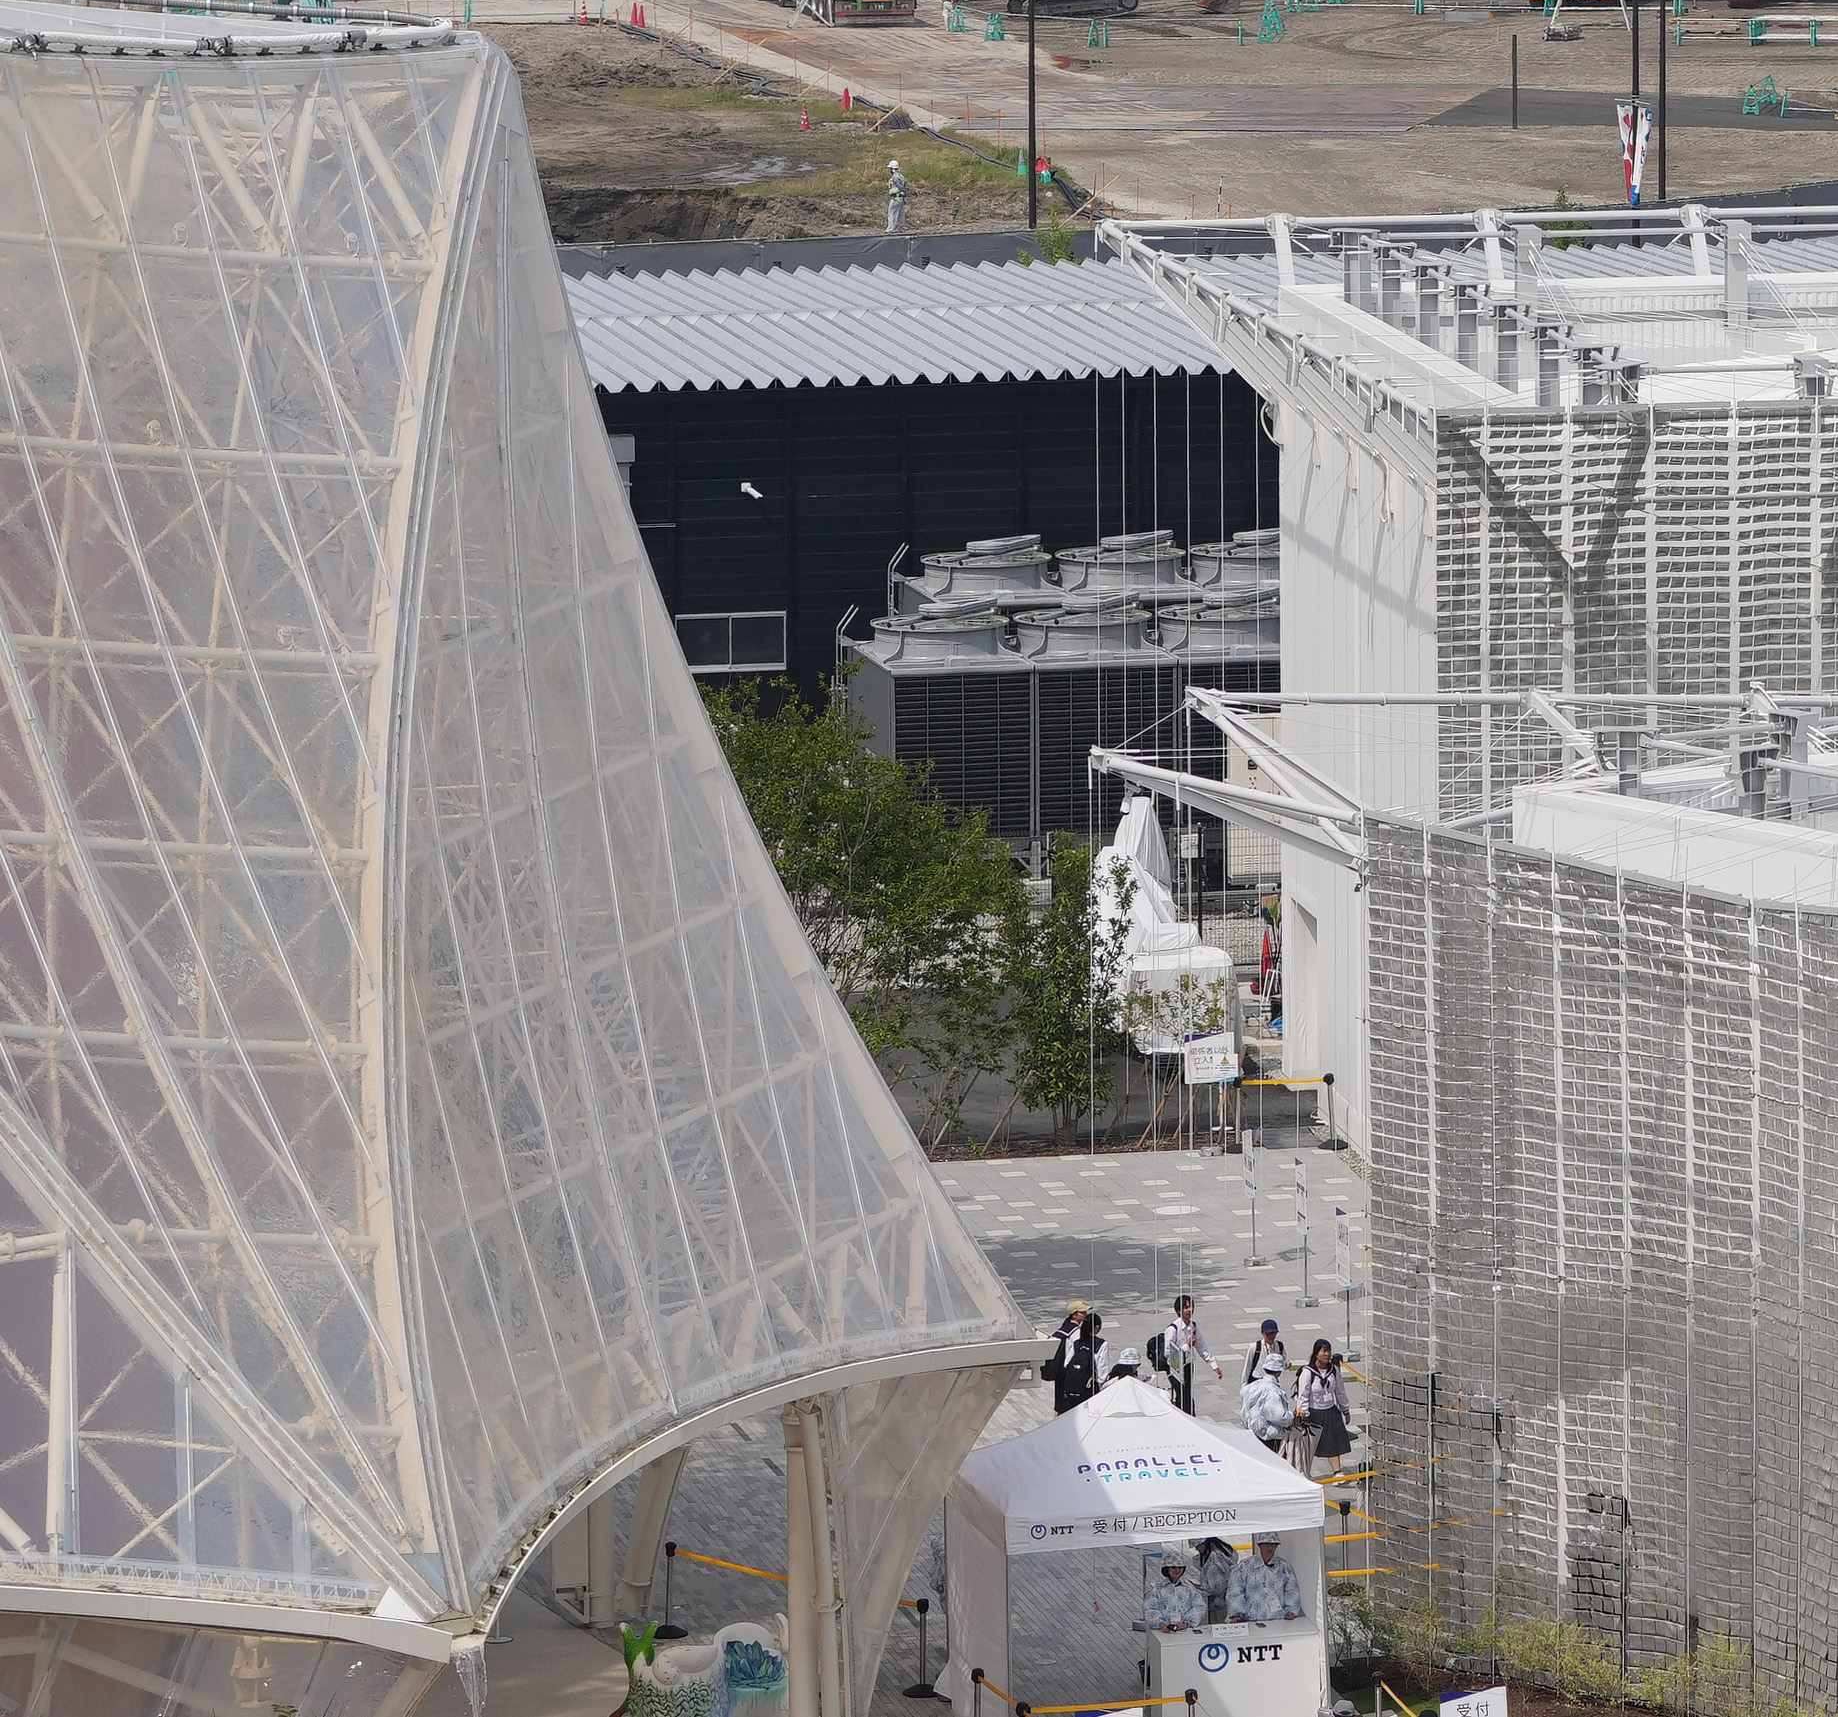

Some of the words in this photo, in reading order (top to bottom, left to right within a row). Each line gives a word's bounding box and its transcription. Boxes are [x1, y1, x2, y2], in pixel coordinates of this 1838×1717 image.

[1077, 1454, 1223, 1474] PARALLEL
[1099, 1467, 1208, 1483] TRAVEL
[1050, 1525, 1074, 1536] NTT
[1092, 1517, 1128, 1535] 受付
[1142, 1509, 1237, 1529] RECEPTION
[1237, 1644, 1283, 1663] NTT
